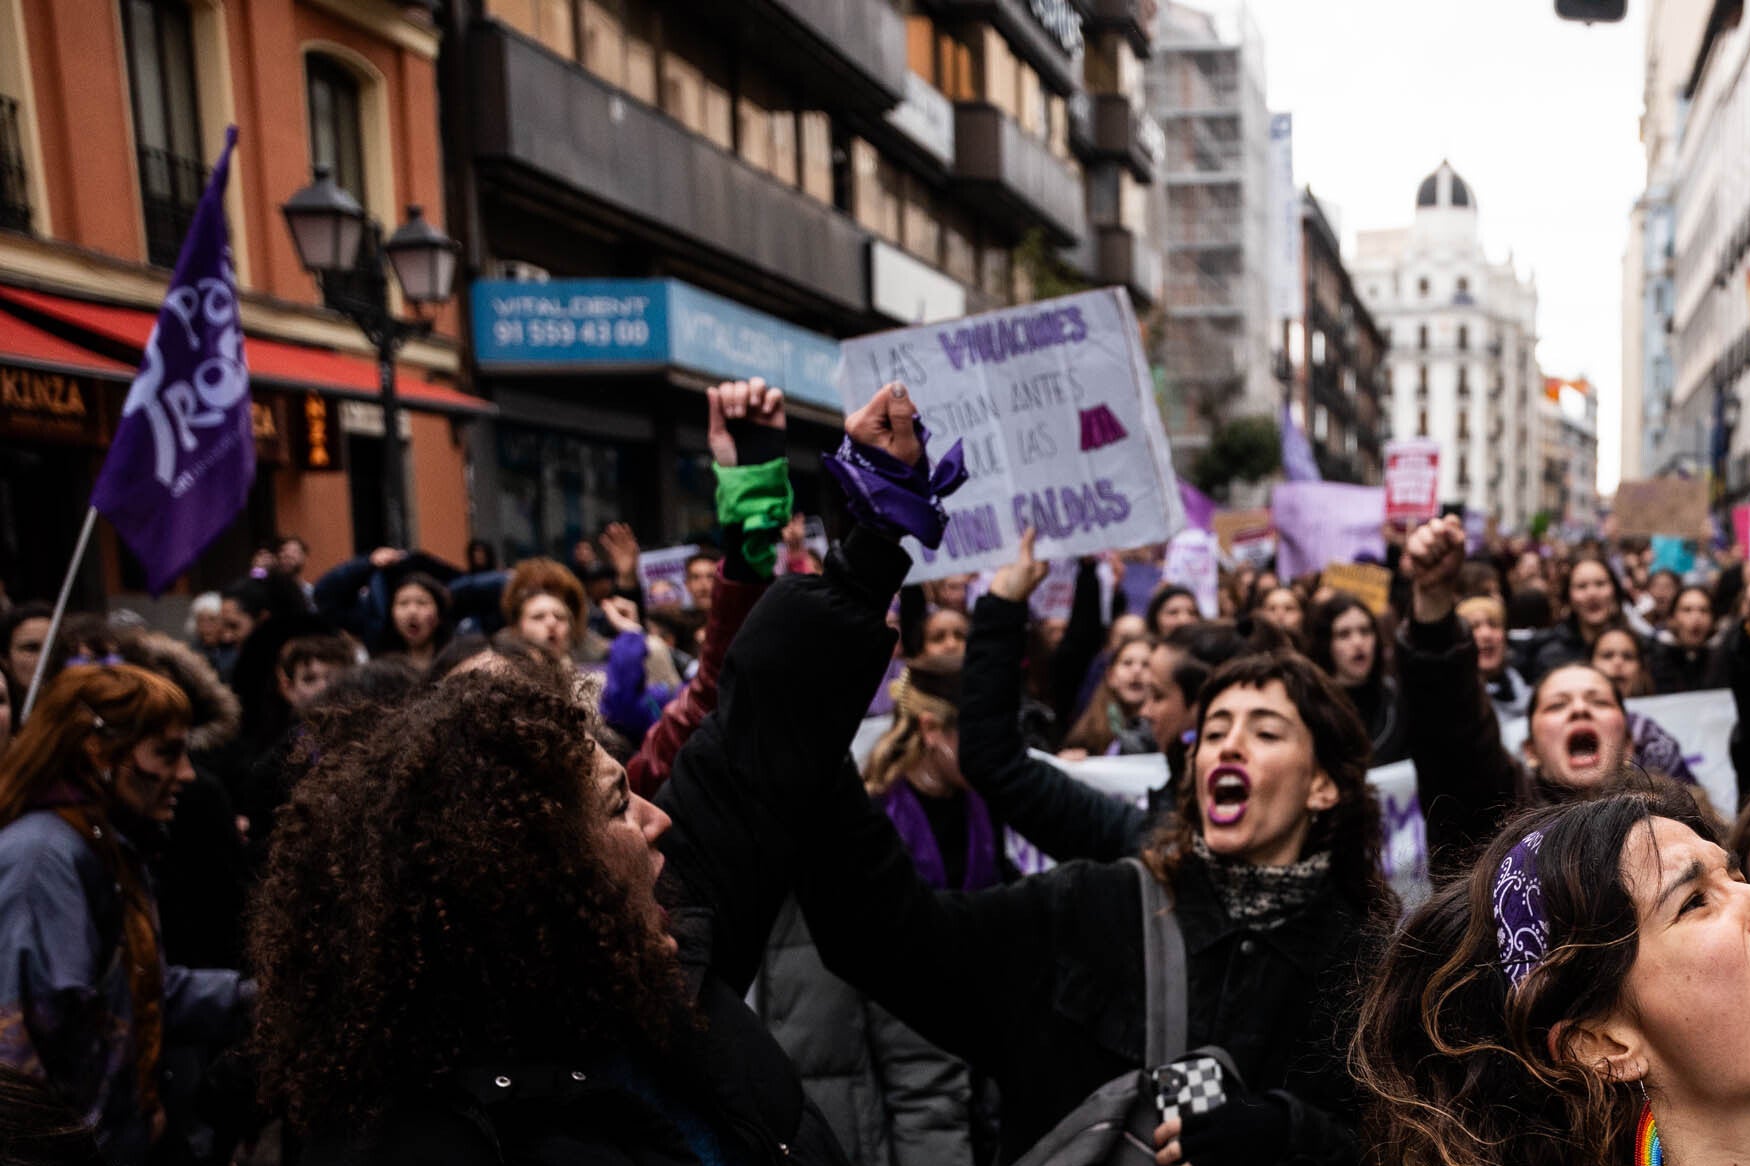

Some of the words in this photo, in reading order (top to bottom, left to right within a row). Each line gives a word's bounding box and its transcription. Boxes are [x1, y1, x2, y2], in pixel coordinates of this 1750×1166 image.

[492, 295, 649, 316] VITALDENT
[492, 319, 524, 346] 91
[614, 318, 650, 346] 00
[869, 342, 928, 389] LAS
[1, 366, 87, 415] KINZA
[923, 388, 1002, 442] STÍAN
[1010, 366, 1086, 415] ANTES
[968, 436, 1004, 480] UE
[1016, 421, 1059, 466] LAS
[1011, 476, 1132, 543] FALDAS
